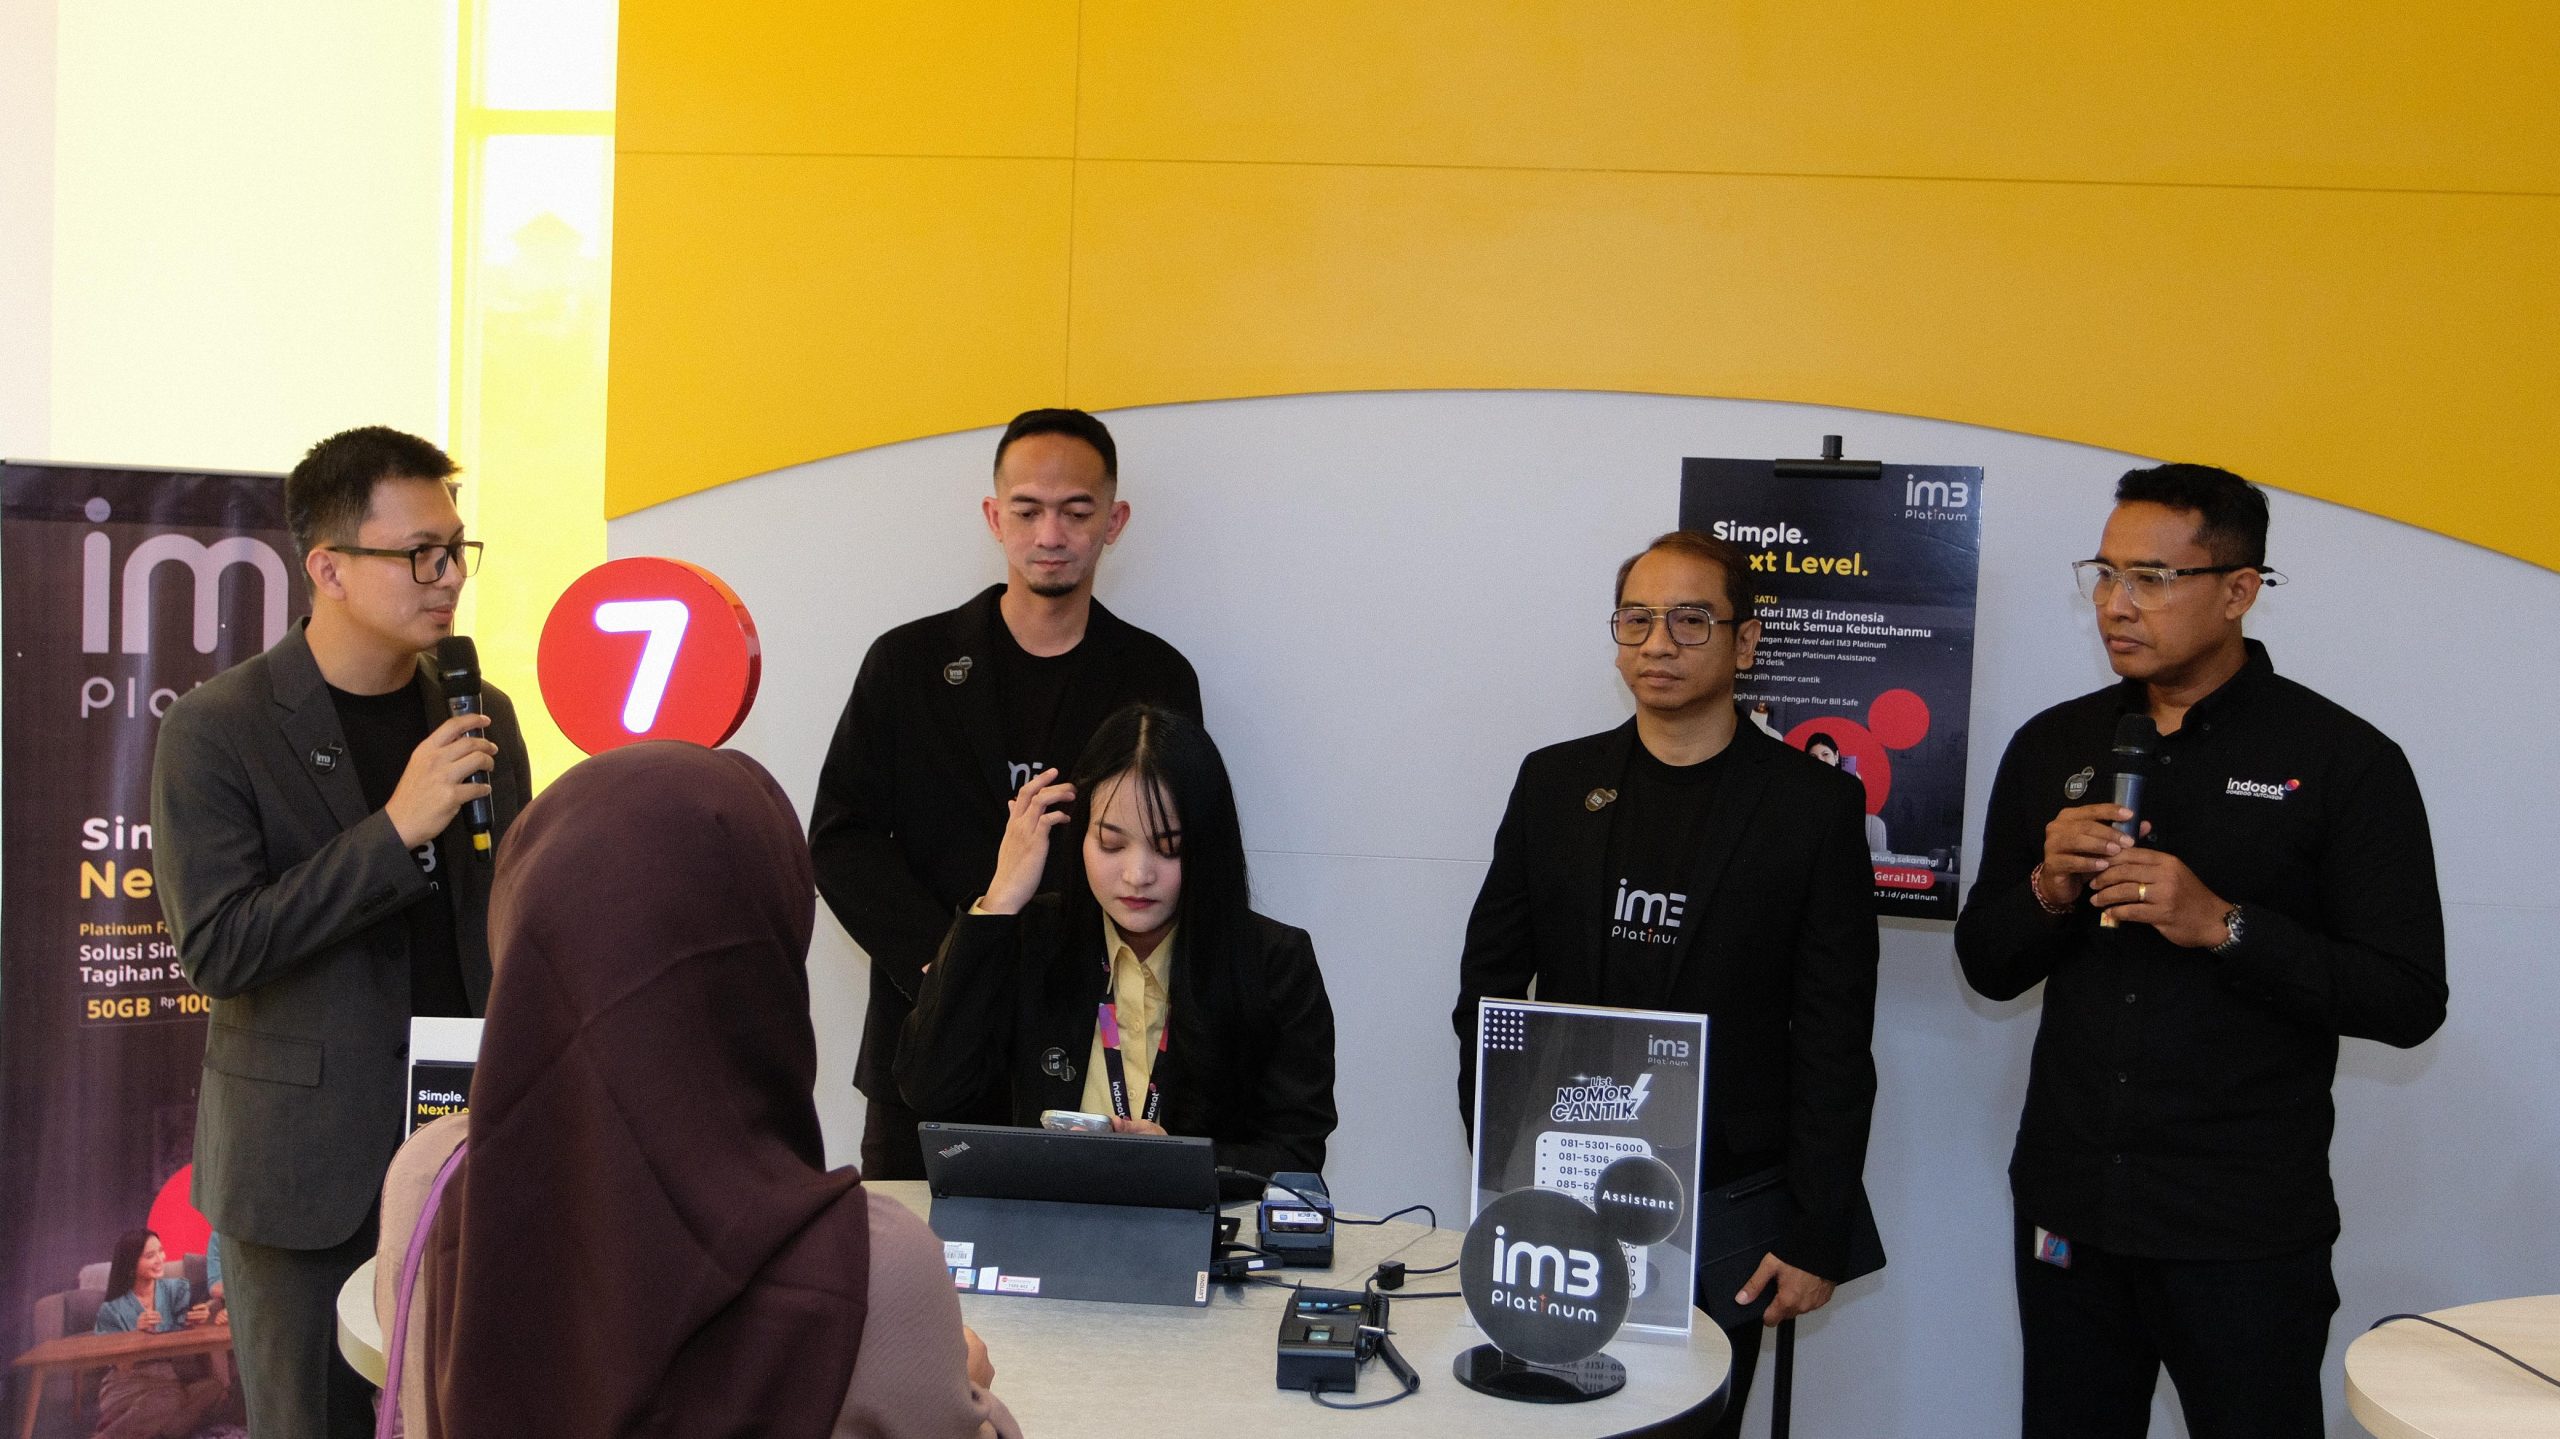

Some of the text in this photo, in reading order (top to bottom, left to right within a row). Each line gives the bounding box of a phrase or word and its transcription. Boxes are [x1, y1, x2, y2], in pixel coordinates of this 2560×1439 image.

[1905, 474, 1969, 508] im3
[1904, 508, 1968, 521] Platinum
[1713, 520, 1809, 549] Simple.
[1785, 551, 1869, 577] Level.
[1760, 607, 1784, 620] dari
[1786, 608, 1809, 621] IM3
[1812, 609, 1822, 621] di
[1825, 610, 1884, 623] Indonesia
[1765, 621, 1931, 638] untuk Semua Kebutuhanmu
[1783, 637, 1801, 645] Next
[1802, 638, 1819, 646] level
[1819, 639, 1835, 647] dari
[1836, 640, 1851, 648] IM3
[1852, 641, 1887, 649] Platinum
[1766, 659, 1785, 667] detik
[1773, 650, 1800, 661] dengan
[1802, 651, 1836, 661] Platinum
[1837, 653, 1877, 663] Assistance
[594, 599, 690, 734] 7
[1754, 673, 1770, 682] pilih
[1771, 674, 1797, 682] nomor
[1798, 675, 1820, 685] cantik
[1759, 694, 1781, 702] aman
[1782, 695, 1810, 706] dengan
[1811, 697, 1828, 705] fitur
[1829, 697, 1841, 706] Bill
[1842, 698, 1859, 708] Safe
[2227, 777, 2285, 797] indosat
[1898, 857, 1939, 867] sekarang!
[1874, 872, 1928, 884] Gerai IM3
[79, 922, 153, 937] Platinum
[79, 943, 143, 962] Solusi
[79, 964, 164, 987] Tagihan
[87, 998, 151, 1020] 50GB
[1648, 1034, 1689, 1058] im3
[1591, 1075, 1612, 1087] List
[418, 1089, 466, 1104] Simple.
[1112, 1080, 1126, 1118] indosat
[1556, 1085, 1633, 1105] NOMOR
[417, 1103, 450, 1116] Next
[1550, 1100, 1638, 1123] CANTIK
[1560, 1138, 1643, 1153] 081-5301-6000
[1602, 1190, 1675, 1210] Assistant
[1492, 1225, 1600, 1297] im3
[1491, 1289, 1597, 1323] Platinum
